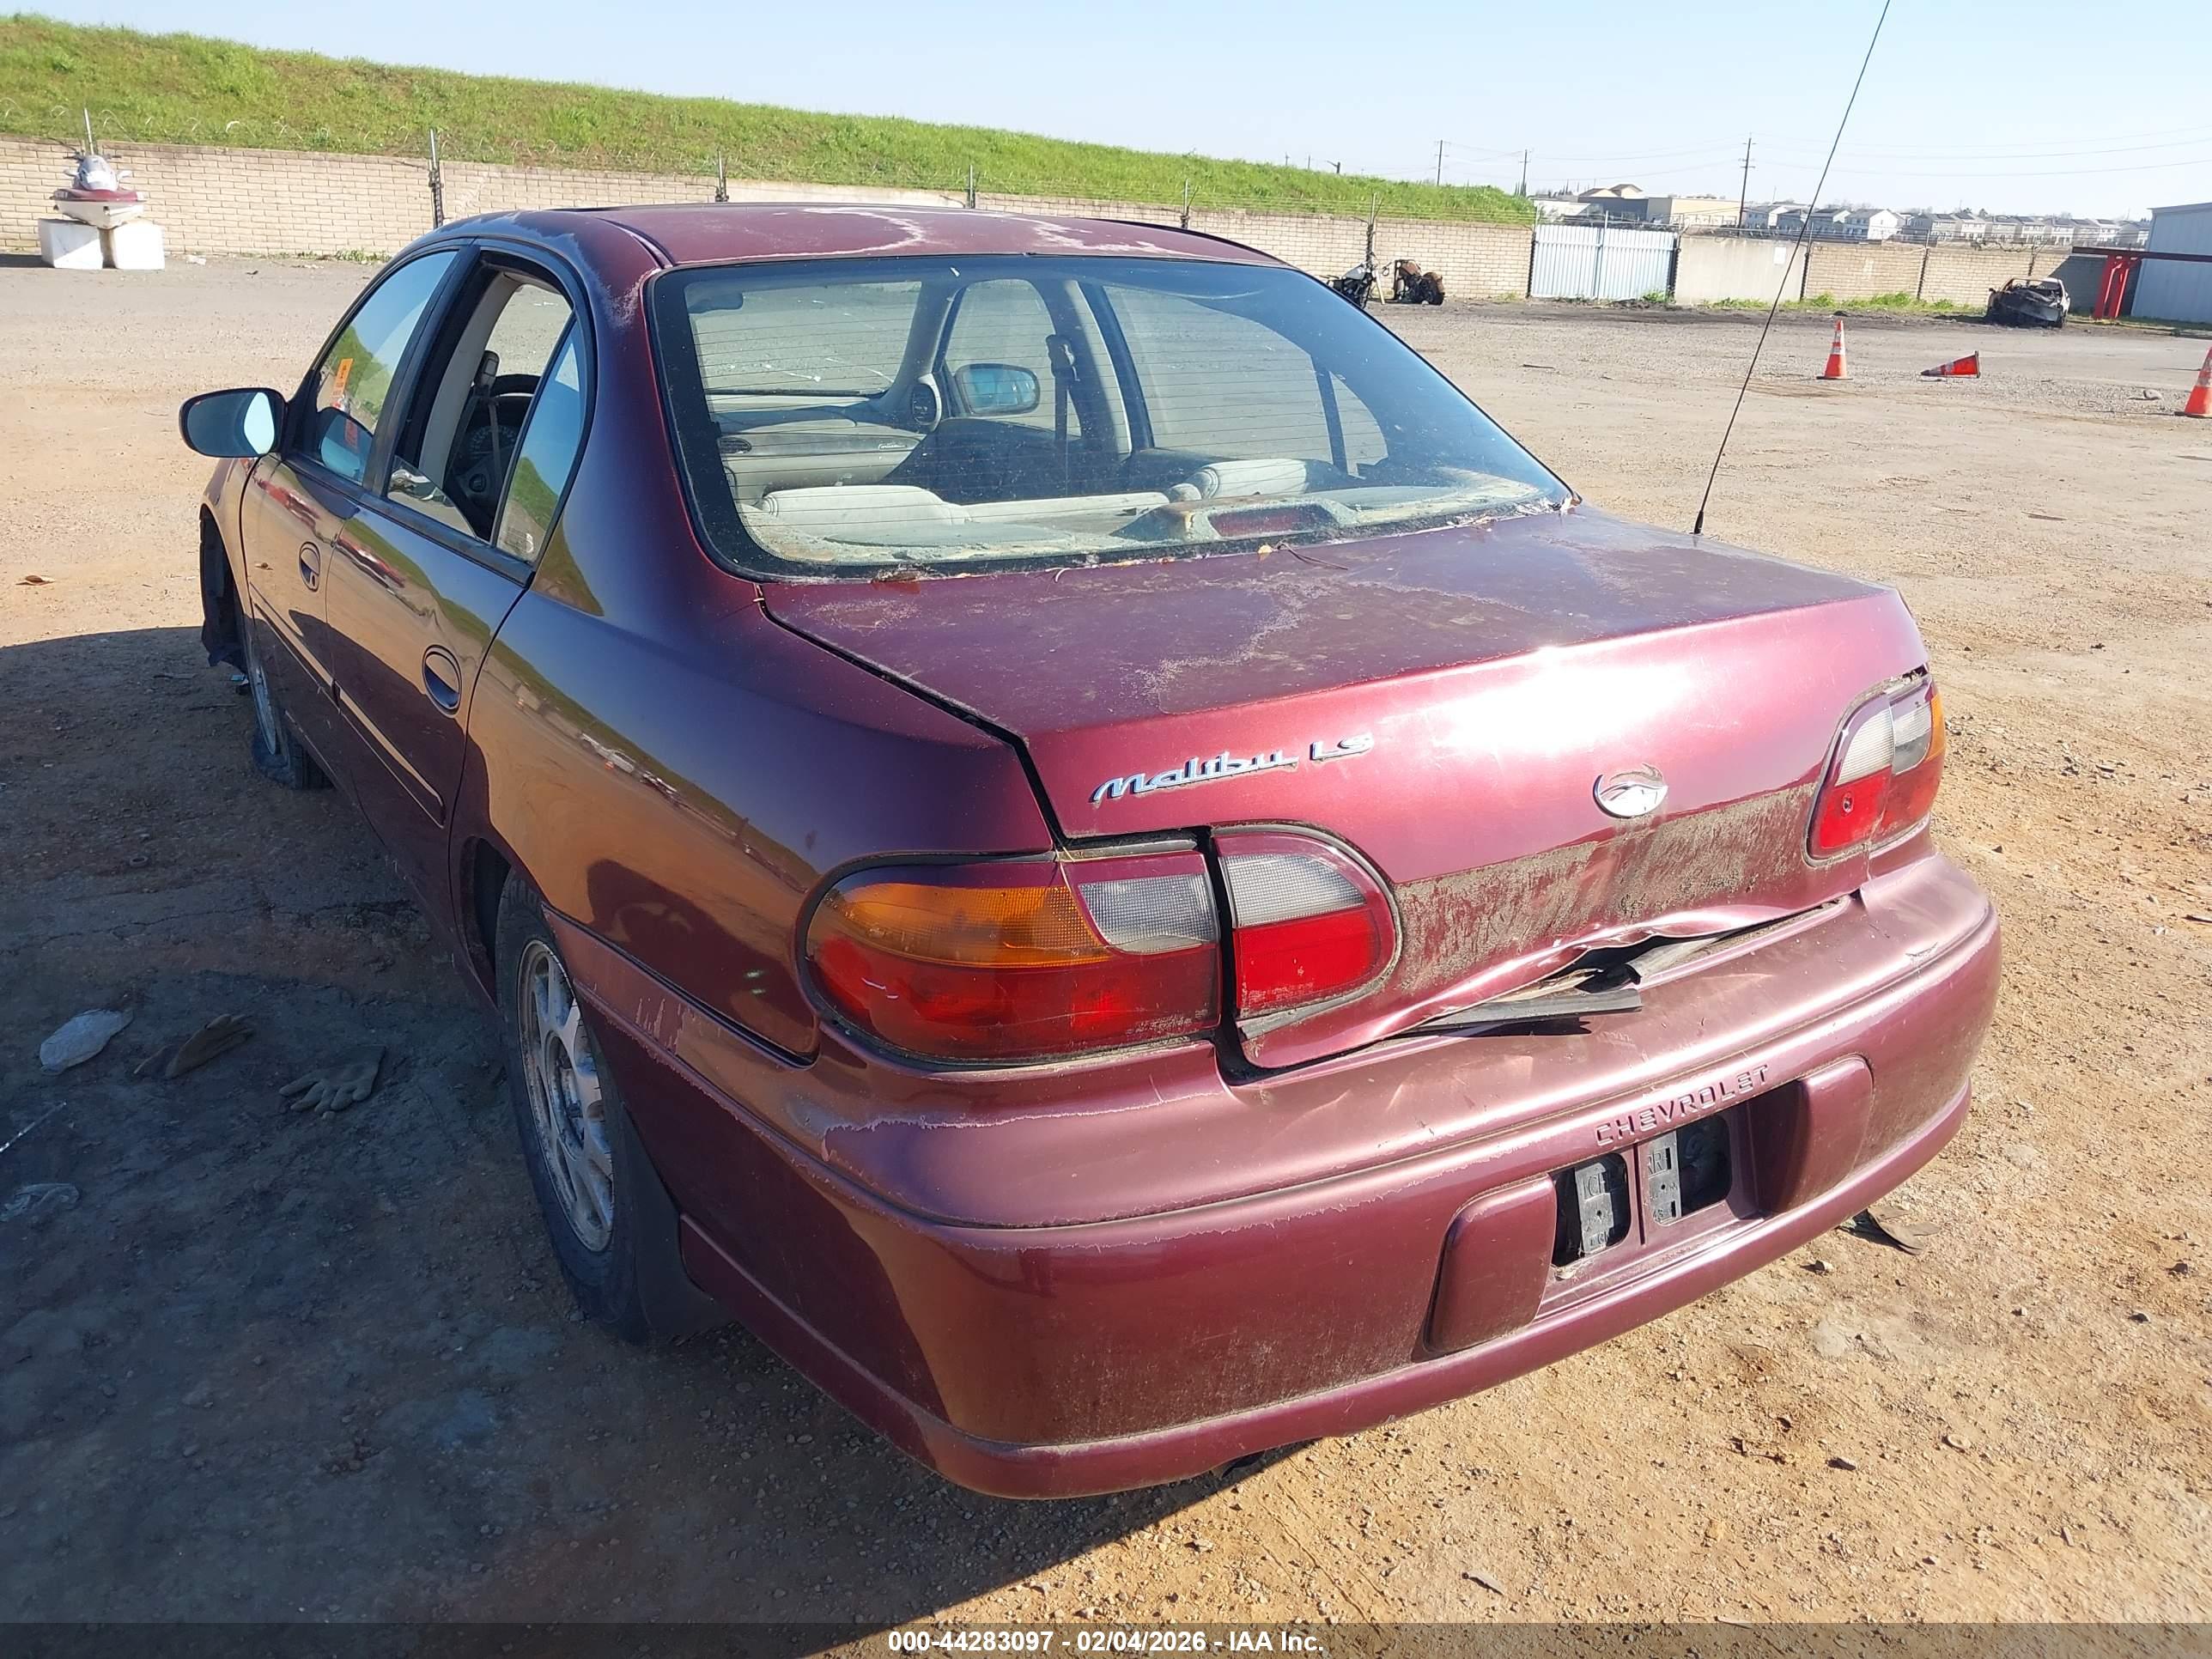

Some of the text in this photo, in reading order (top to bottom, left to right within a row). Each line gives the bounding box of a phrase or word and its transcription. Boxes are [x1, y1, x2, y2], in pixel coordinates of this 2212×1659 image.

[1090, 732, 1375, 803] Malibu LS
[1595, 1064, 1769, 1146] CHEVROLET
